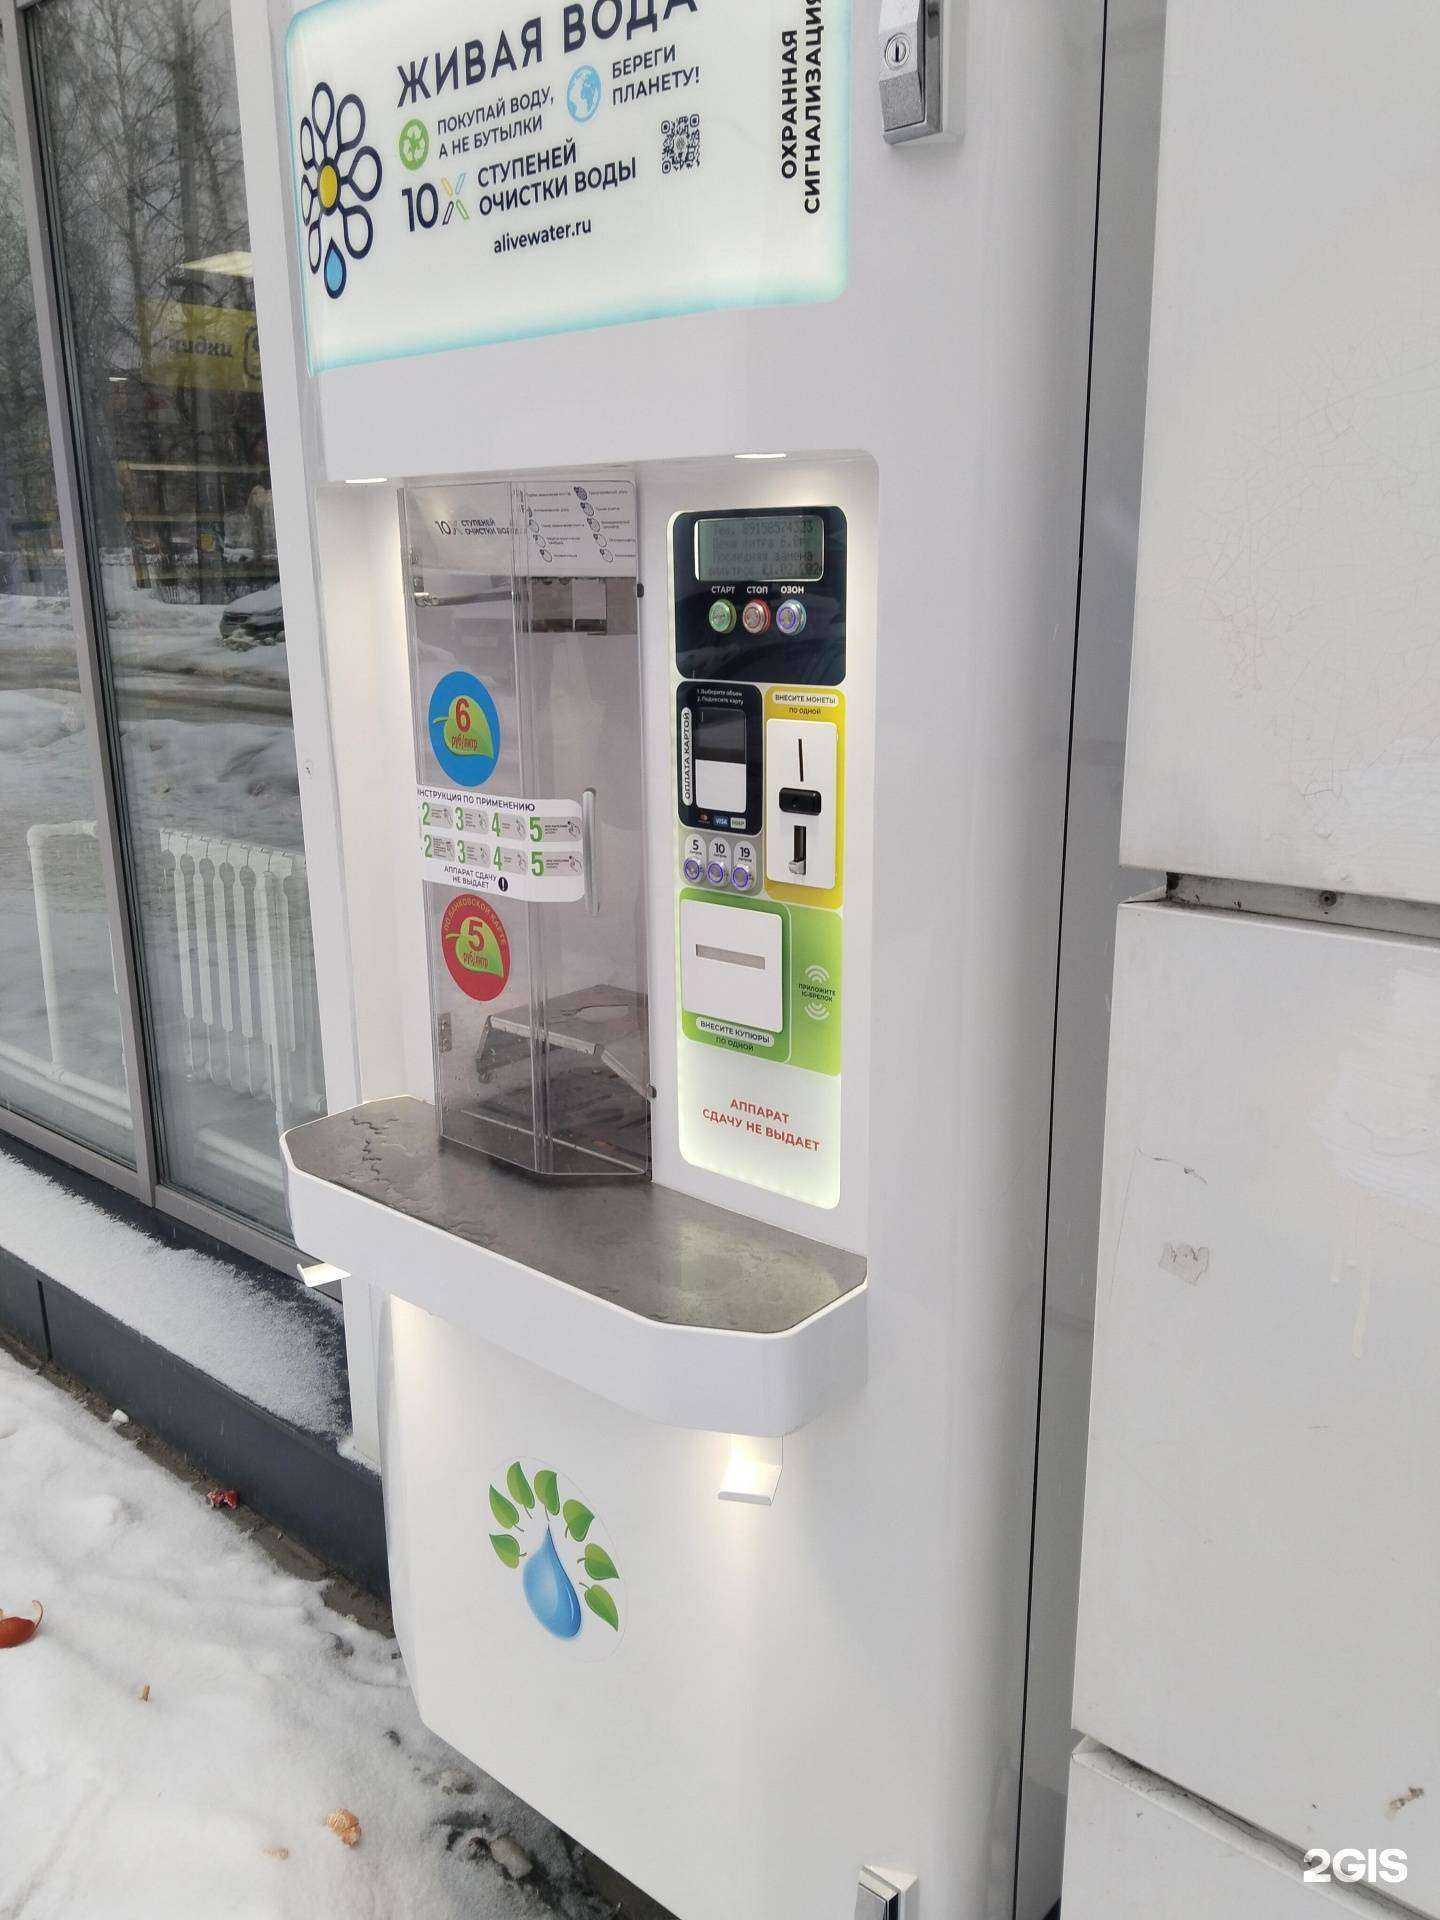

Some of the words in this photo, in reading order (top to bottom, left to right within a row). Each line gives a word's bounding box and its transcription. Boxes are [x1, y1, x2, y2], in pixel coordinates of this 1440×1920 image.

[397, 16, 543, 108] ЖИВАЯ
[612, 44, 676, 79] БЕРЕГИ
[612, 66, 700, 106] ПЛАНЕТУ!
[437, 96, 506, 135] ПОКУПАЙ
[510, 85, 554, 114] ВОДУ,
[781, 30, 798, 179] ОХРАННАЯ
[438, 143, 448, 159] А
[452, 136, 470, 156] НЕ
[474, 115, 543, 149] БУТЫЛКИ
[478, 137, 577, 188] СТУПЕНЕЙ
[479, 175, 568, 216] ОЧИСТКИ
[574, 156, 637, 193] ВОДЫ
[401, 182, 439, 232] 10
[493, 218, 592, 254] alivewater.ru
[711, 585, 736, 594] СТАРТ
[746, 585, 769, 594] СТОП
[780, 585, 805, 594] ОЗОН
[775, 694, 805, 702] ВНЕСИТЕ
[806, 696, 836, 704] МОНЕТЫ
[798, 706, 821, 715] ОДНОЙ
[455, 697, 471, 733] 6
[422, 801, 431, 826] 2
[463, 795, 475, 804] ПО
[476, 796, 535, 812] ПРИМЕНЕНИЮ
[455, 806, 464, 831] 3
[491, 812, 501, 837] 4
[529, 816, 543, 842] 5
[424, 834, 433, 858] 2
[457, 840, 466, 864] 3
[692, 839, 699, 851] 5
[714, 842, 726, 855] 10
[740, 847, 750, 858] 19
[493, 846, 502, 871] 4
[531, 851, 544, 877] 5
[444, 865, 474, 877] АППАРАТ
[475, 871, 497, 882] СДАЧУ
[462, 877, 489, 889] ВЫДАЕТ
[467, 919, 485, 952] 5
[700, 1020, 734, 1035] ВНЕСИТЕ
[735, 1030, 770, 1044] КУПЮРЫ
[715, 1036, 726, 1045] ПО
[727, 1039, 754, 1052] ОДНОЙ
[730, 1098, 789, 1124] АППАРАТ
[702, 1108, 742, 1128] СДАЧУ
[746, 1120, 763, 1135] НЕ
[765, 1127, 820, 1152] ВЫДАЕТ
